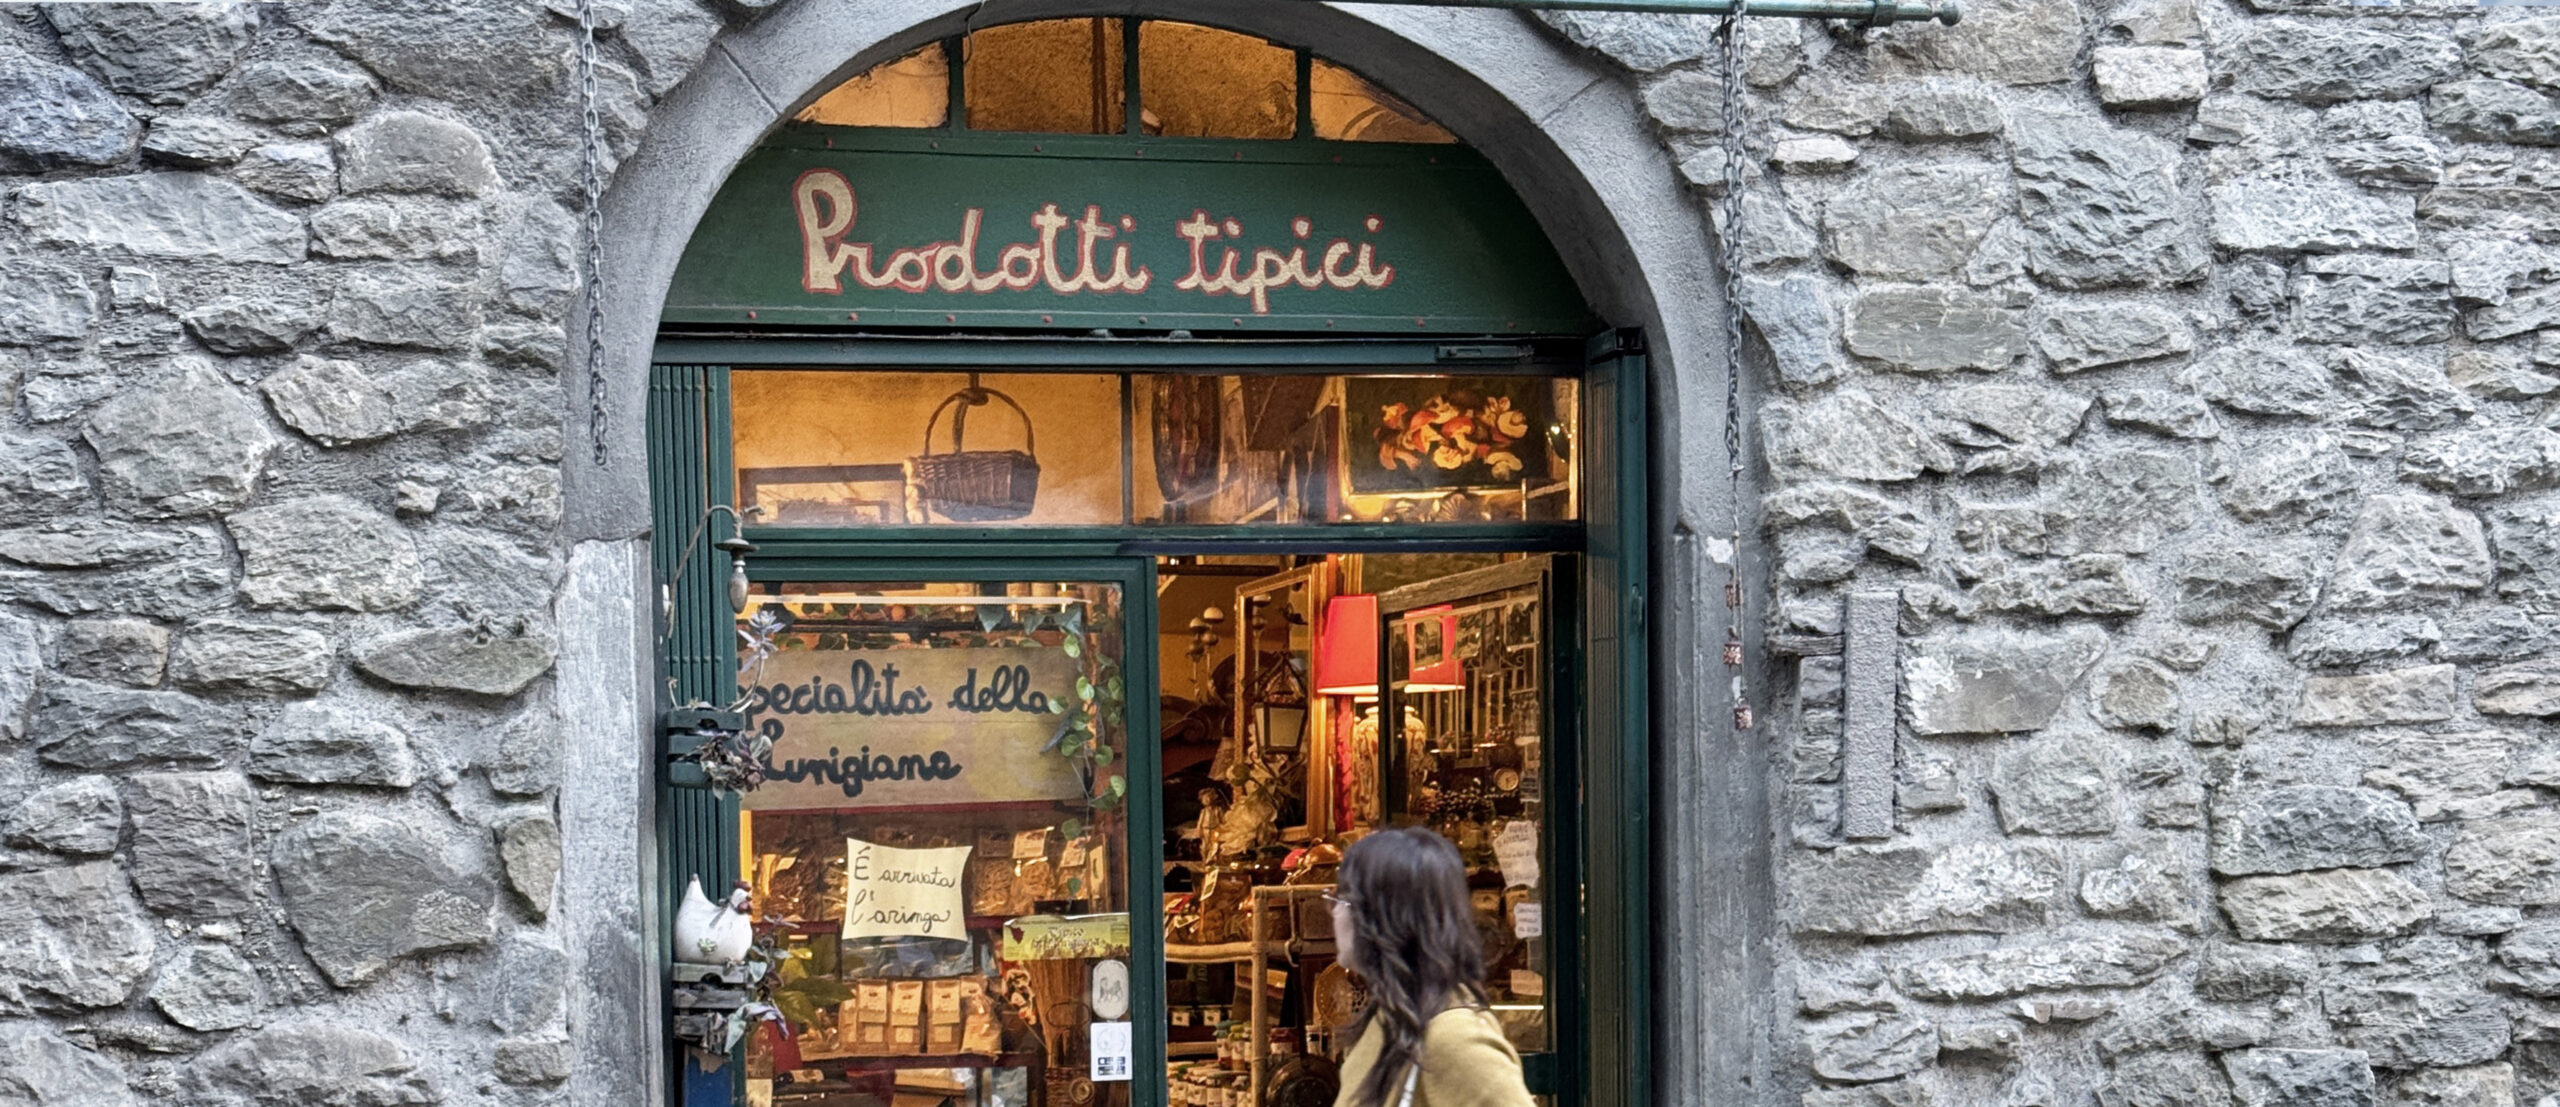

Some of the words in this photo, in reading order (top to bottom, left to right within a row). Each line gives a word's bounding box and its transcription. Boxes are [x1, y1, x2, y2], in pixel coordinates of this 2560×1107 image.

[794, 168, 1152, 293] Prodotti
[1174, 210, 1394, 315] tipici
[737, 658, 932, 730] pecialità
[948, 664, 1050, 714] della
